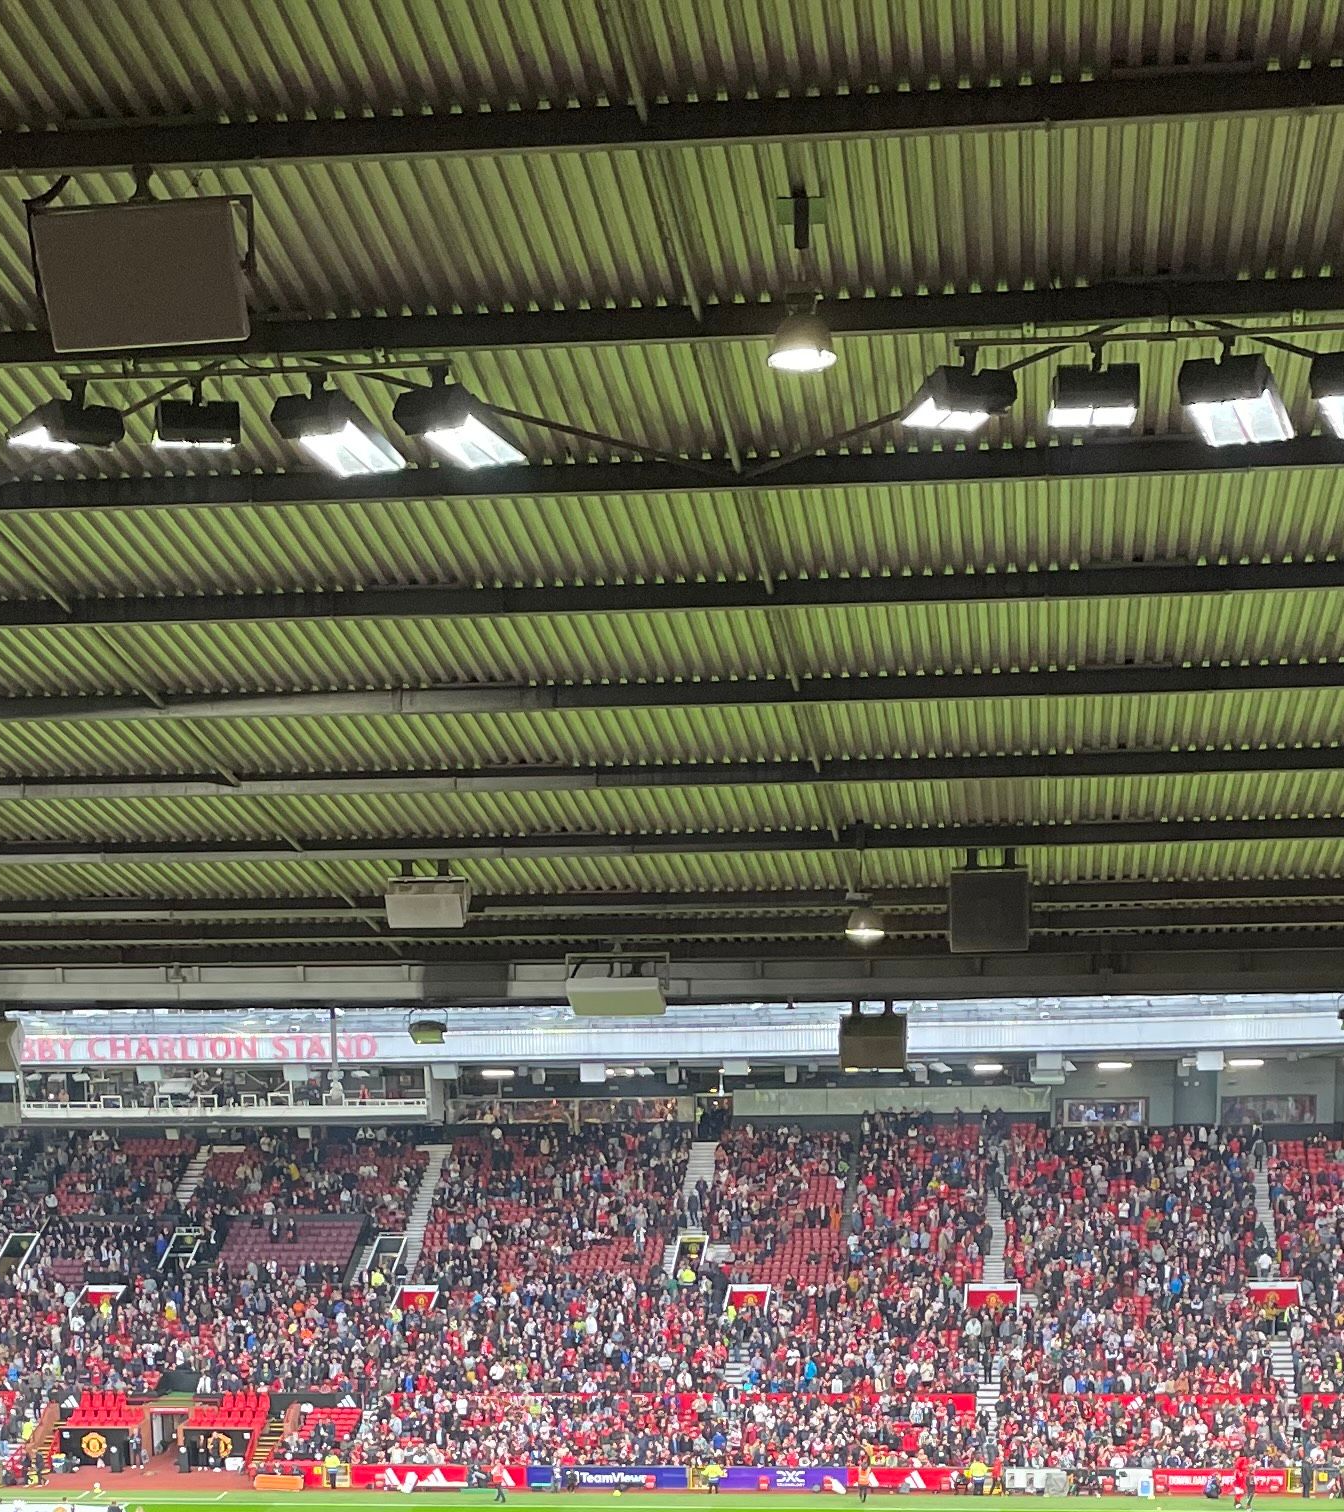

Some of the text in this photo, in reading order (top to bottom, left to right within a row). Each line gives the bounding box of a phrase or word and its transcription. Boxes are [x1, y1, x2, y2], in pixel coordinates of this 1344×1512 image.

[87, 1035, 258, 1061] CHARLTON
[272, 1035, 377, 1061] STAND
[776, 1470, 806, 1483] DXC
